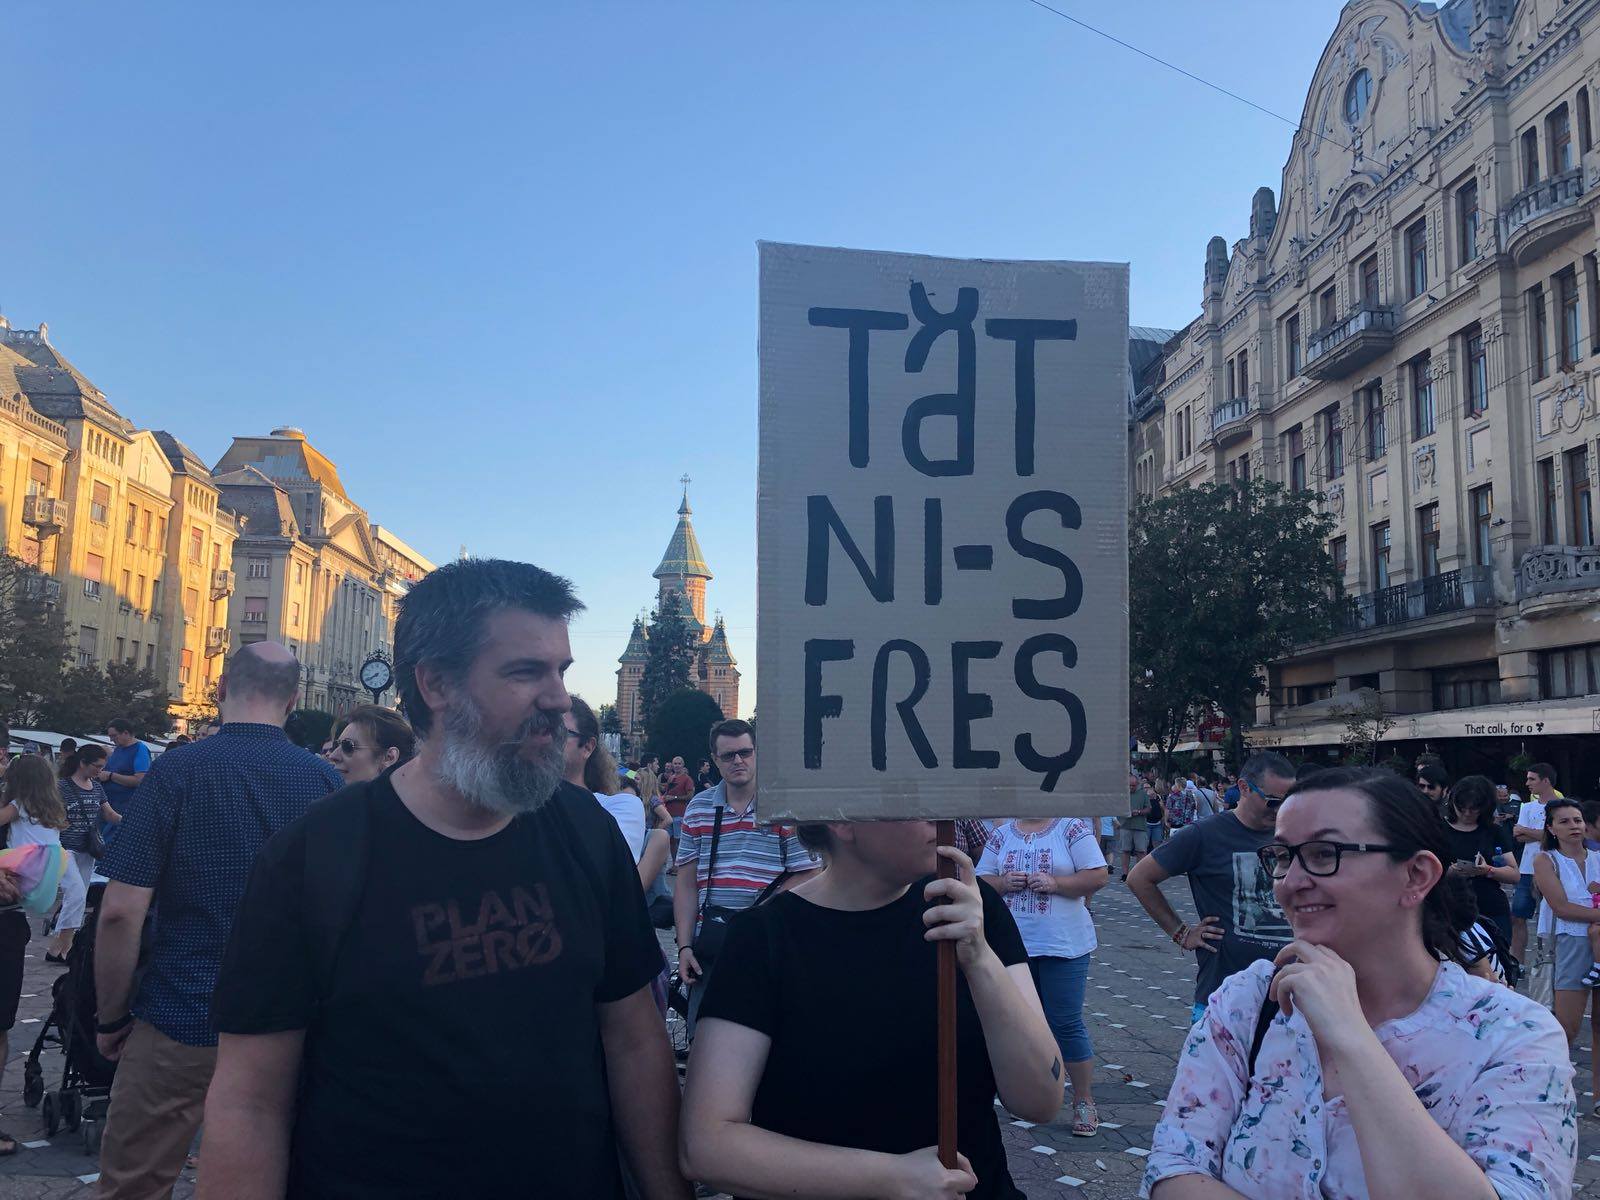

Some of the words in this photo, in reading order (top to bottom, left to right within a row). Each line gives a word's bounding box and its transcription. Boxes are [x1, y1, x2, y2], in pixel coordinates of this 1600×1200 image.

[804, 490, 1083, 620] NI-S
[1465, 724, 1485, 734] That
[1510, 722, 1524, 733] for
[1527, 725, 1533, 733] a
[411, 883, 554, 951] PLAN
